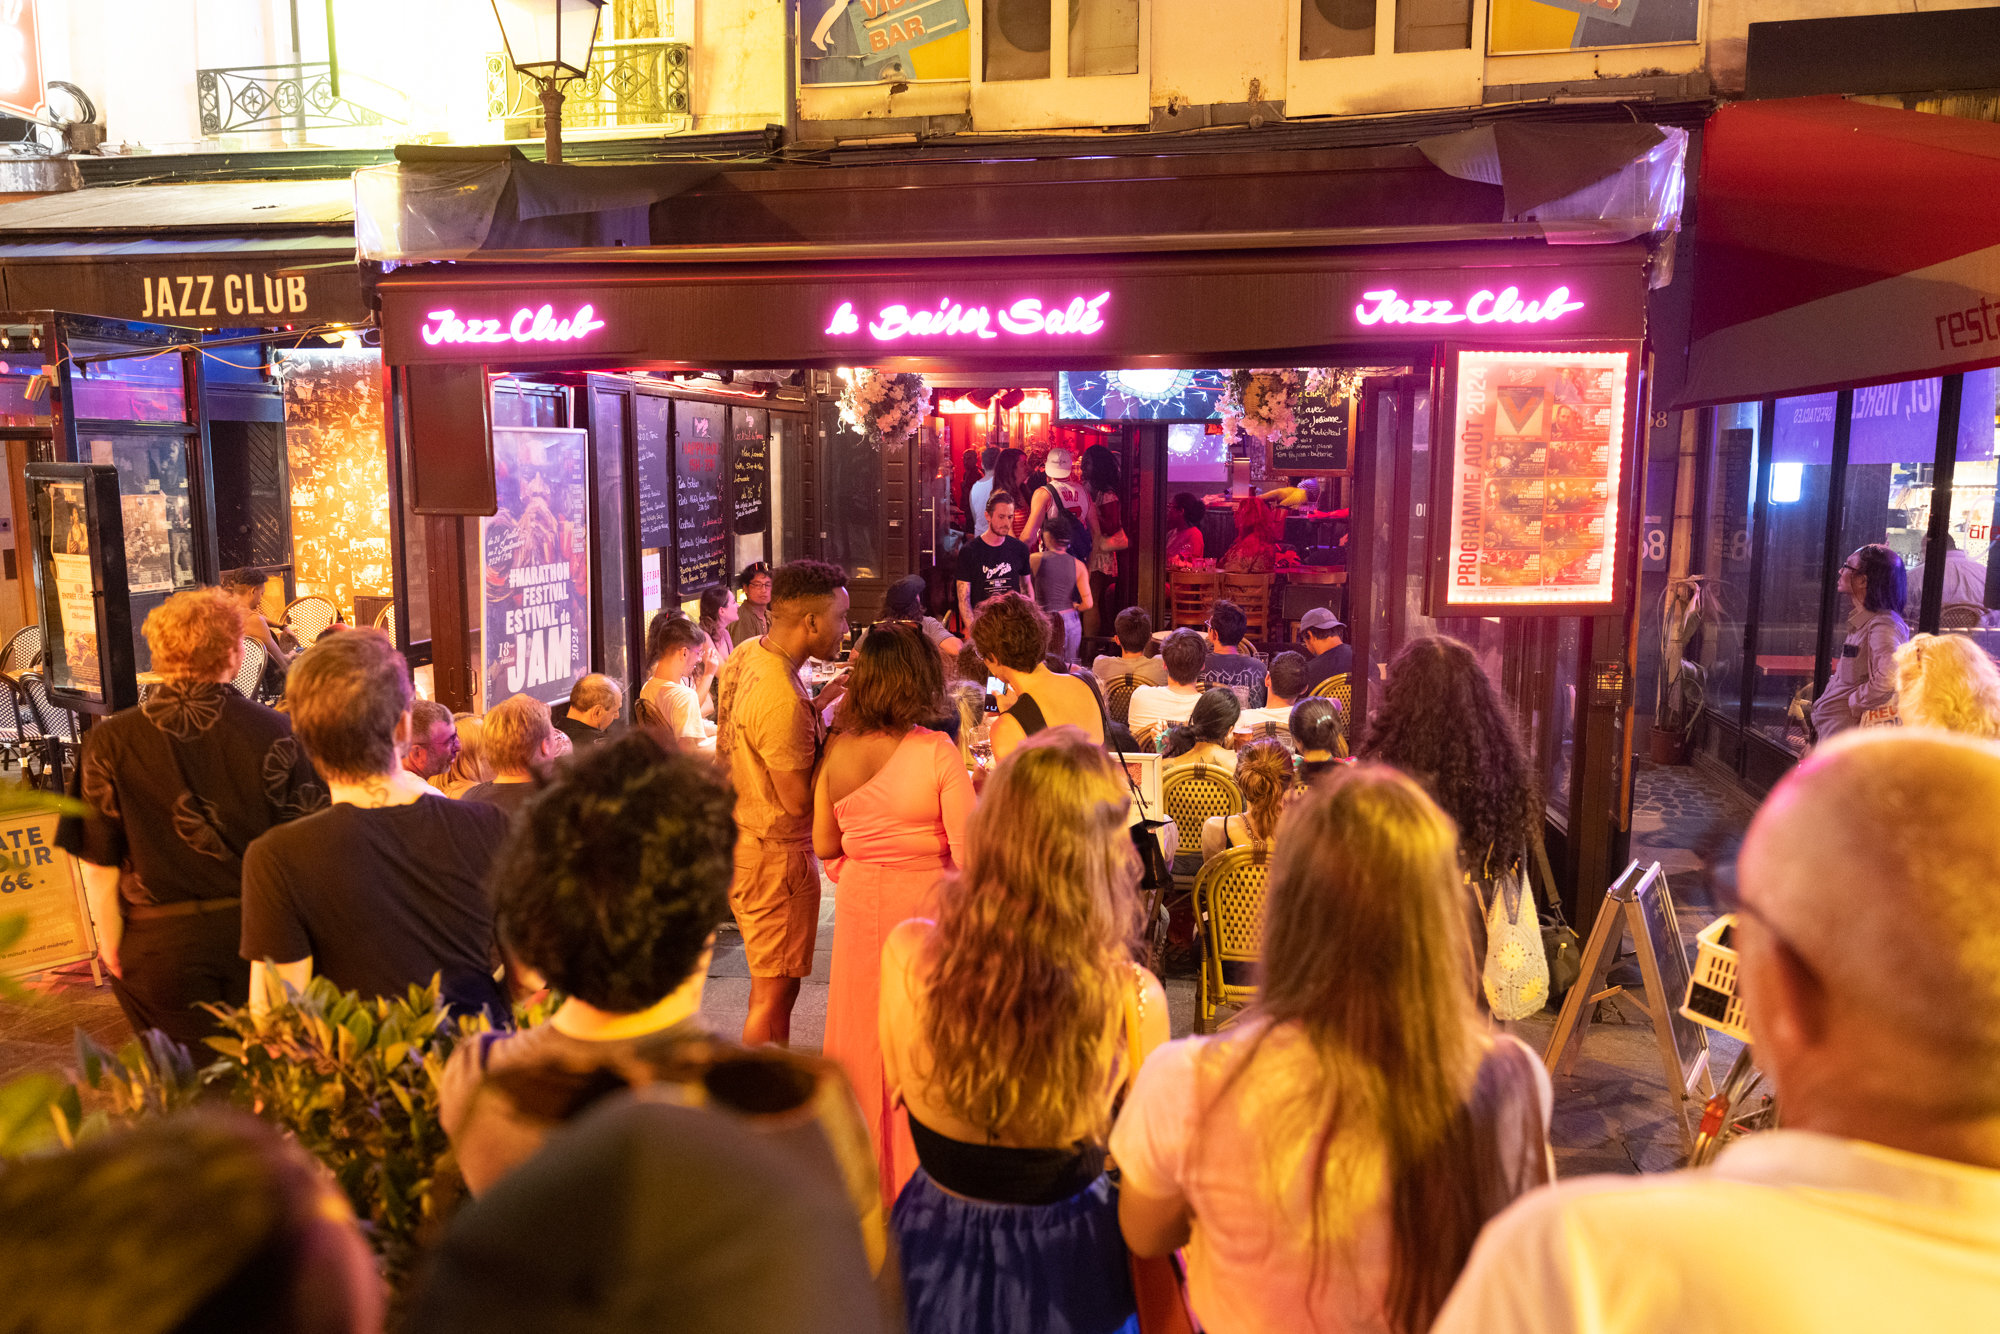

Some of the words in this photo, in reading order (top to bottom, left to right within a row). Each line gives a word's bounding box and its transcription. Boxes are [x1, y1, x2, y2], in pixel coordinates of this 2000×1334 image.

[869, 14, 925, 53] BAR
[142, 275, 214, 317] JAZZ
[224, 274, 307, 315] CLUB
[869, 297, 996, 340] Baiser
[999, 291, 1110, 336] Salé
[1354, 288, 1467, 326] Jazz
[1466, 285, 1585, 323] Club
[421, 309, 510, 345] Jazz
[510, 303, 605, 342] Club
[1305, 406, 1326, 414] avec
[1466, 367, 1488, 415] 2024
[1461, 420, 1484, 468] AOÛT
[1457, 473, 1482, 586] PROGRAMME
[508, 561, 570, 589] #MARATHON
[522, 582, 569, 607] FESTIVAL
[505, 602, 558, 635] ESTIVAL
[560, 608, 570, 625] de
[507, 623, 572, 693] JAM
[571, 628, 580, 661] 2024
[47, 939, 74, 950] midnight
